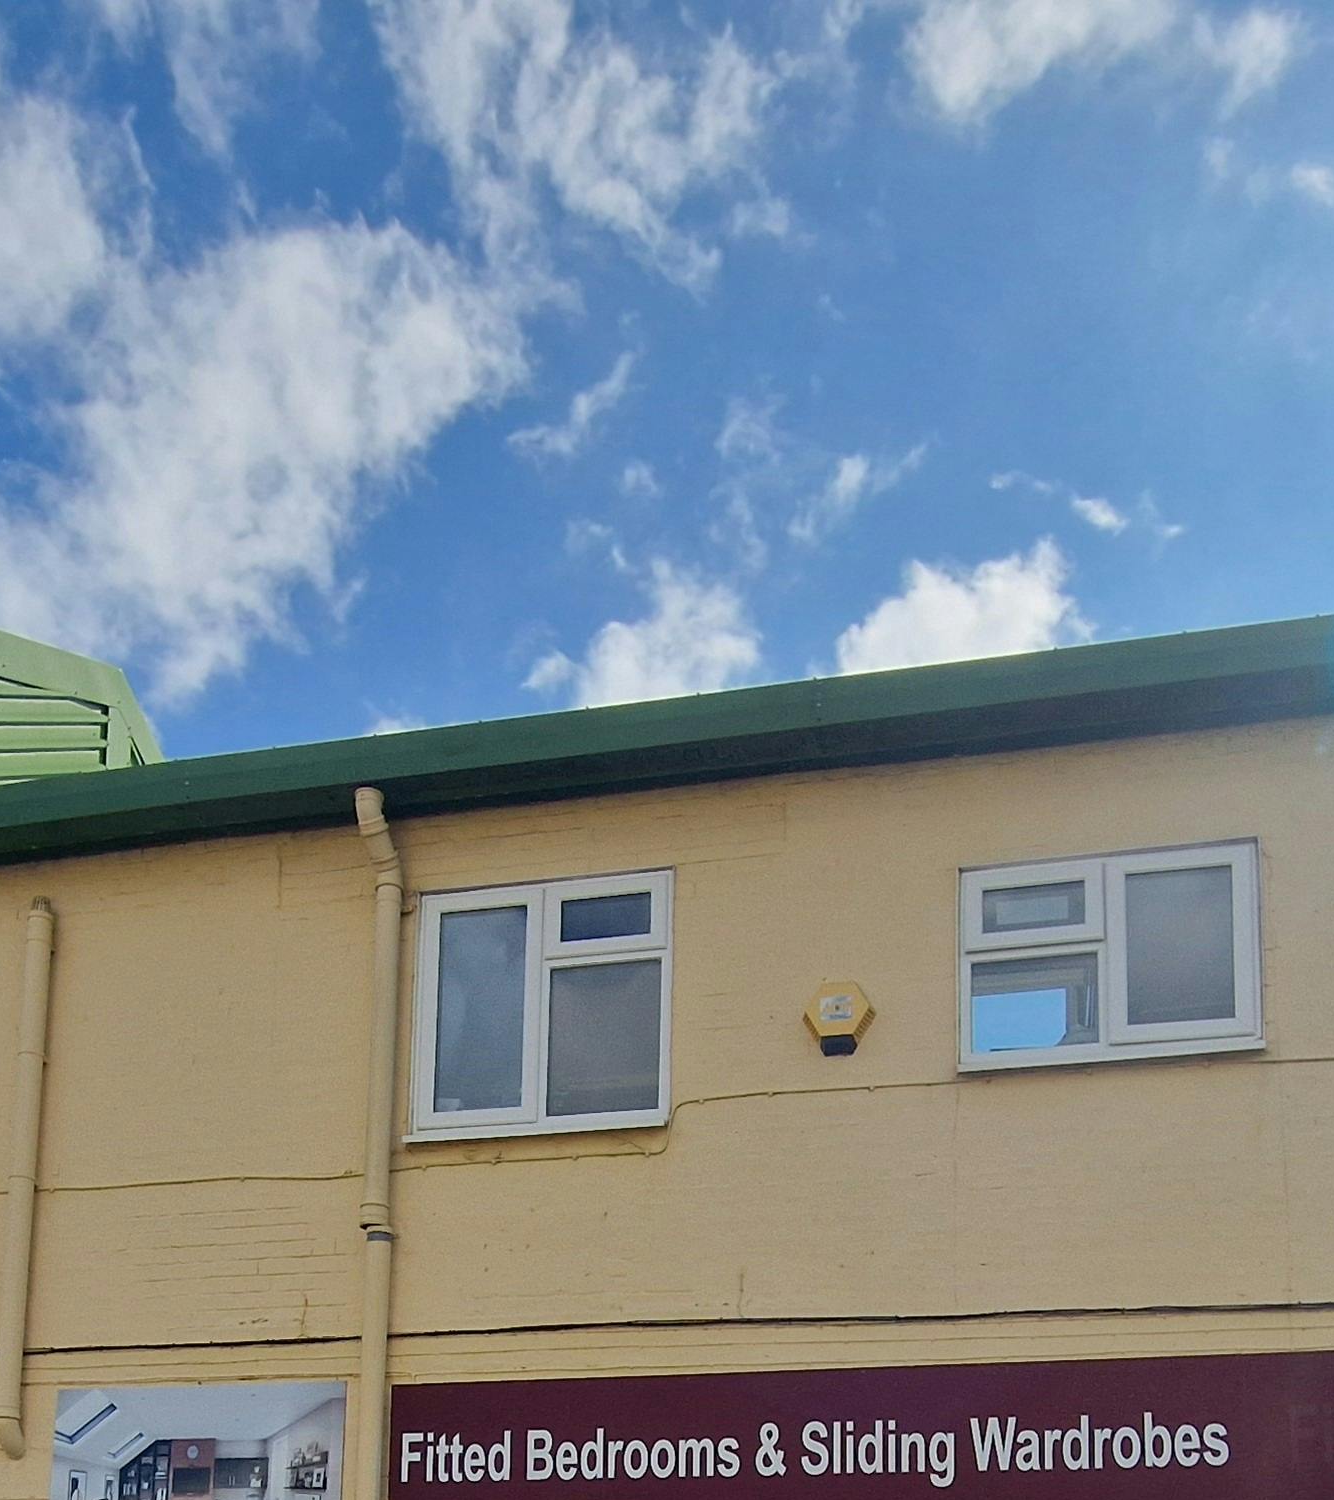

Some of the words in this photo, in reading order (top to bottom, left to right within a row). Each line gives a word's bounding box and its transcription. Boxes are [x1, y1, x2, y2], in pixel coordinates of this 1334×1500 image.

[400, 1429, 512, 1483] Fitted
[526, 1428, 741, 1481] Bedrooms
[755, 1422, 787, 1477] &
[800, 1419, 956, 1489] Sliding
[969, 1412, 1230, 1472] Wardrobes
